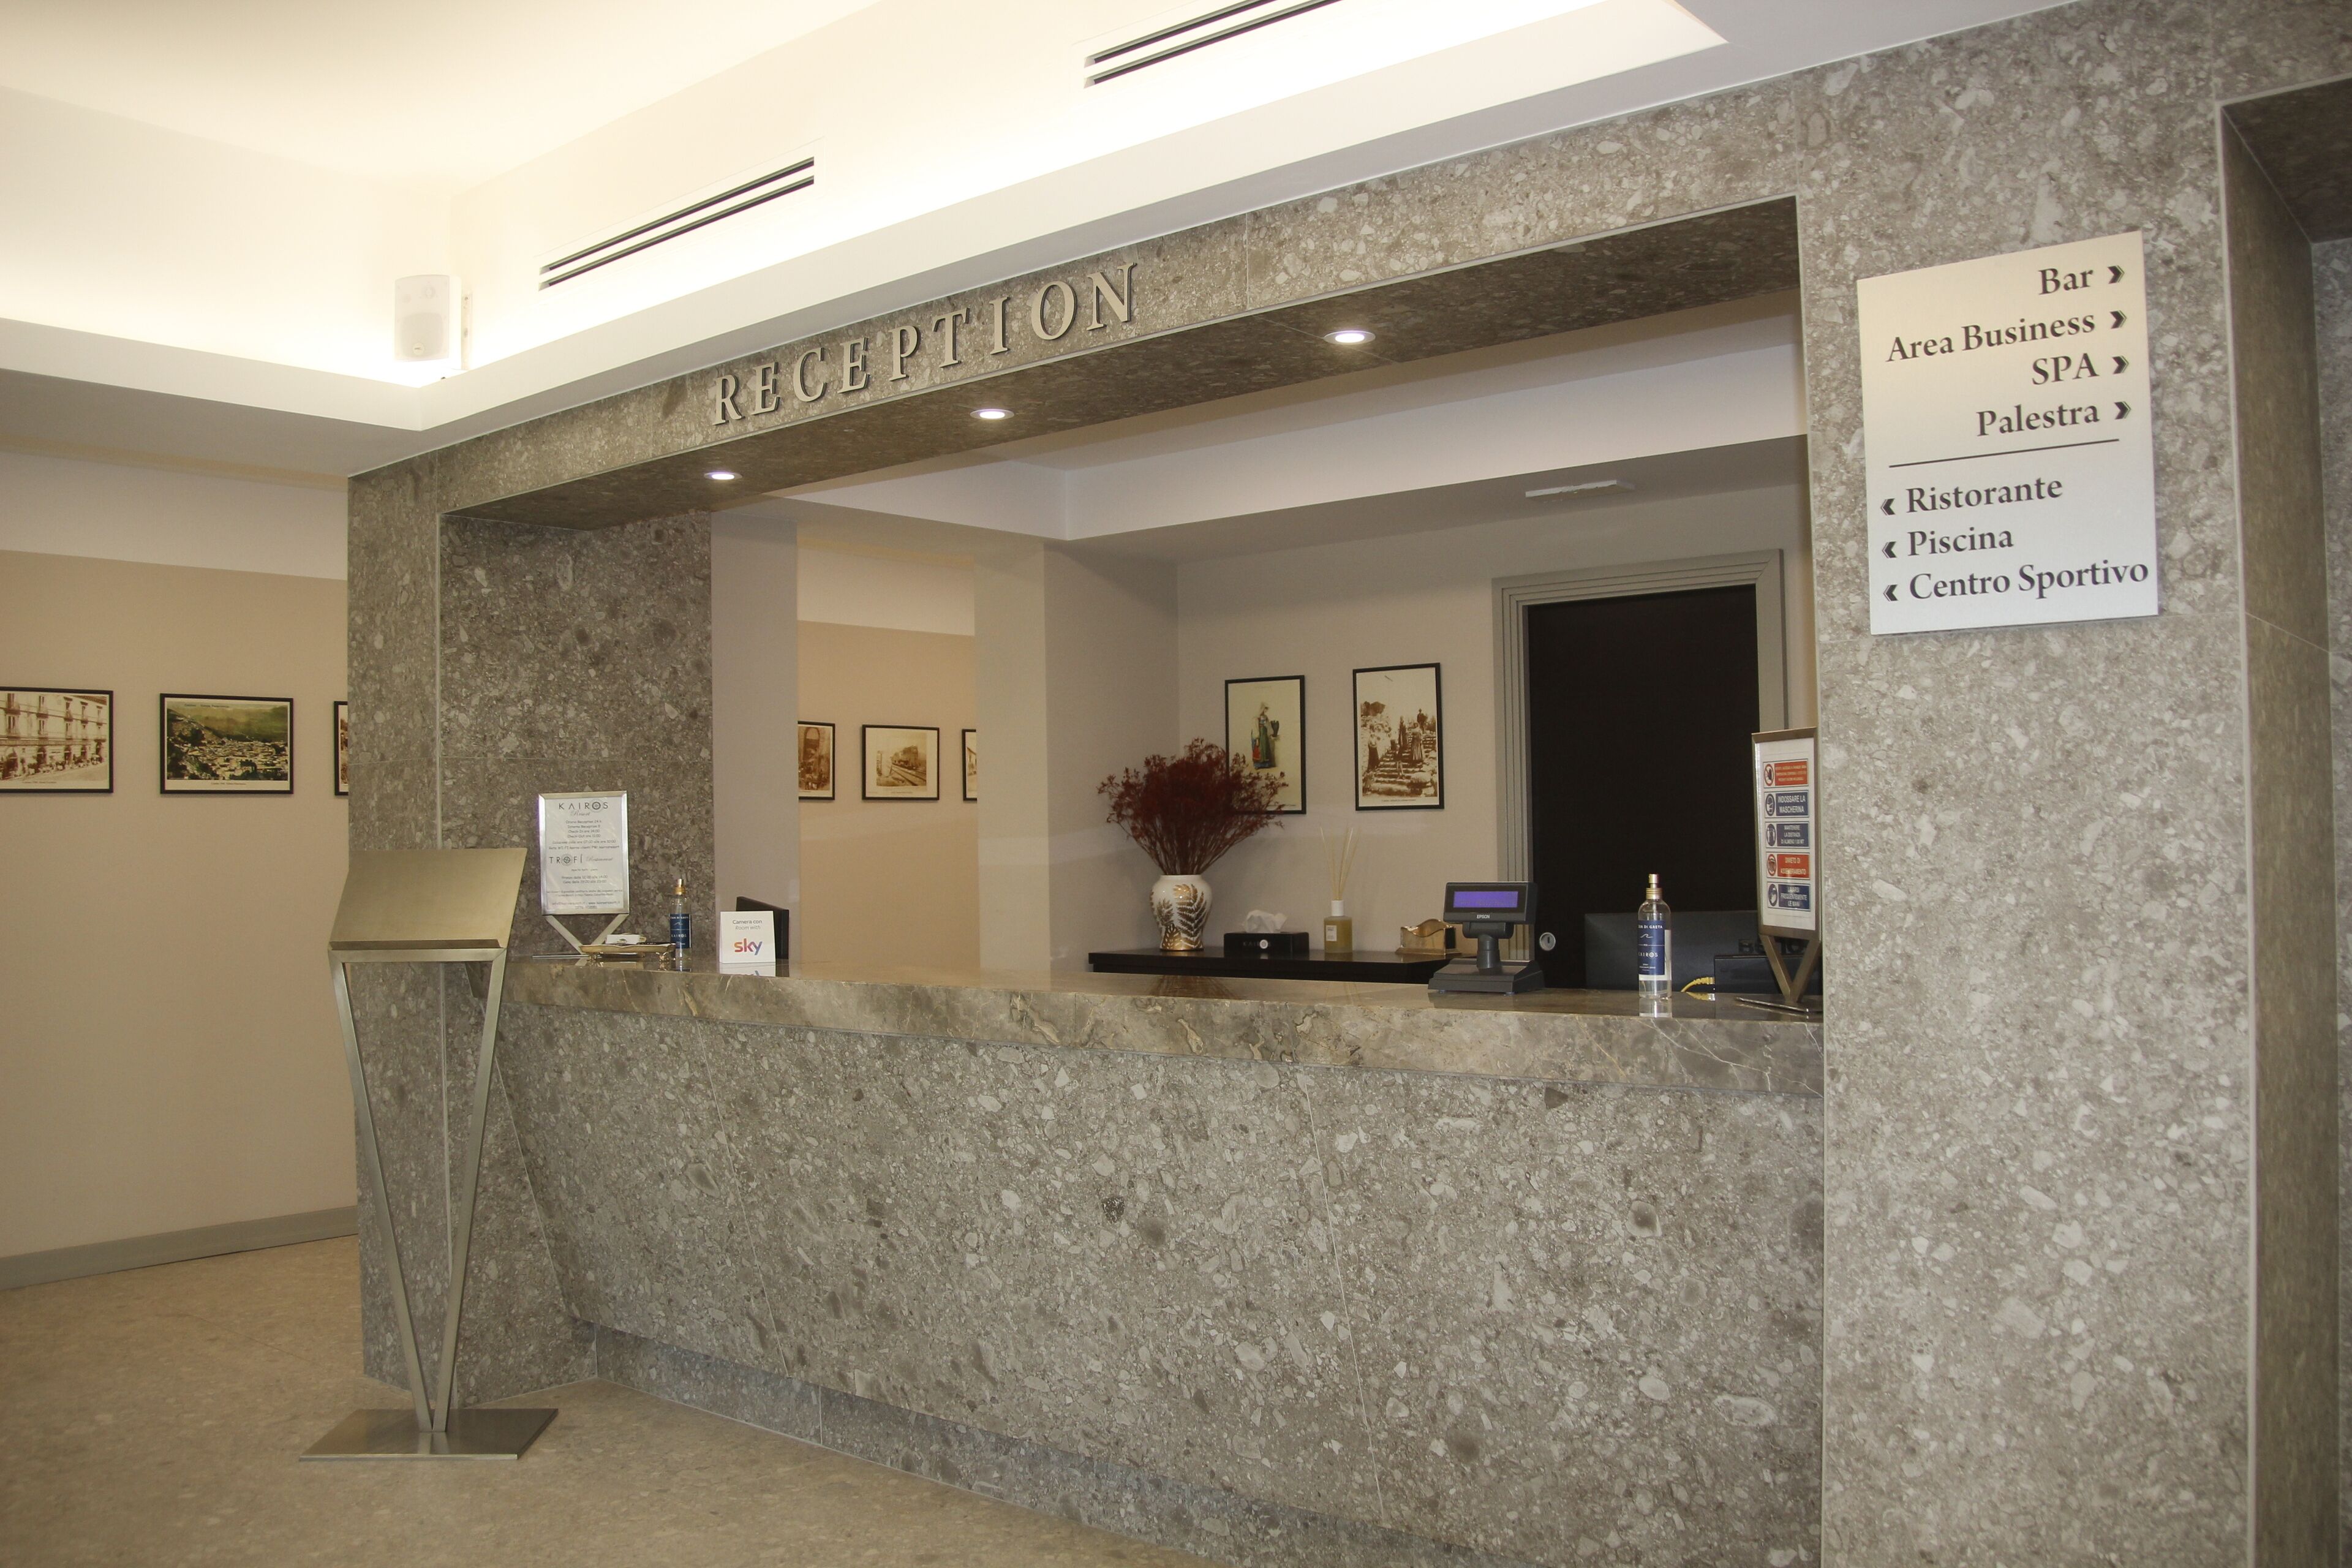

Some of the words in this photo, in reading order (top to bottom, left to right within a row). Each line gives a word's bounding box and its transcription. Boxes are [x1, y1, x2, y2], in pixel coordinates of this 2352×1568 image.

[2039, 266, 2094, 295] Bar
[712, 262, 1137, 425] RECEPTION
[1885, 336, 1954, 362] Area
[1961, 313, 2095, 351] Business
[2032, 352, 2100, 385] SPA
[1977, 404, 2101, 436] Palestra
[1906, 478, 2064, 513] Ristorante
[1908, 527, 2014, 556] Piscina
[1909, 571, 2011, 600] Centro
[2018, 560, 2149, 600] Sportivo
[559, 801, 608, 810] KAIROS
[734, 938, 763, 956] sky
